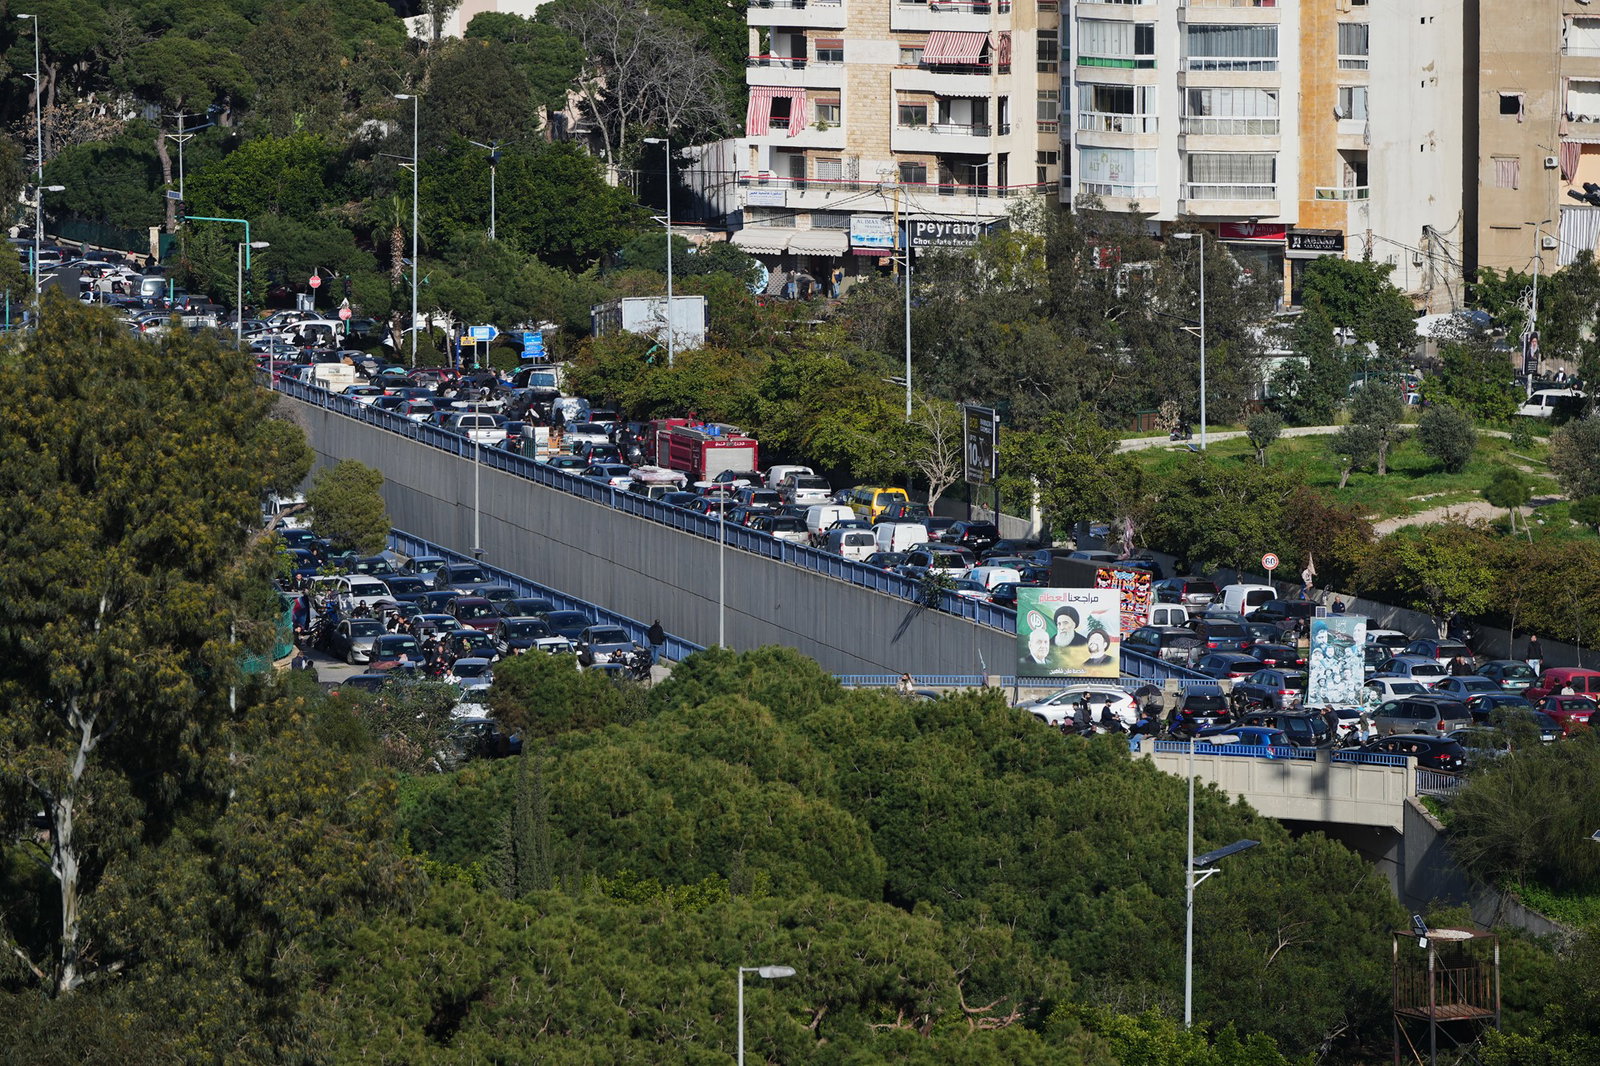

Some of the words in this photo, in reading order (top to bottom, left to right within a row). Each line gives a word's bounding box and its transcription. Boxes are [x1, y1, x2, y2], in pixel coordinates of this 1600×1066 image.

[912, 237, 952, 246] Cholate
[1265, 557, 1276, 566] 60
[1038, 592, 1067, 603] العظام
[1067, 592, 1099, 604] مراجعنا
